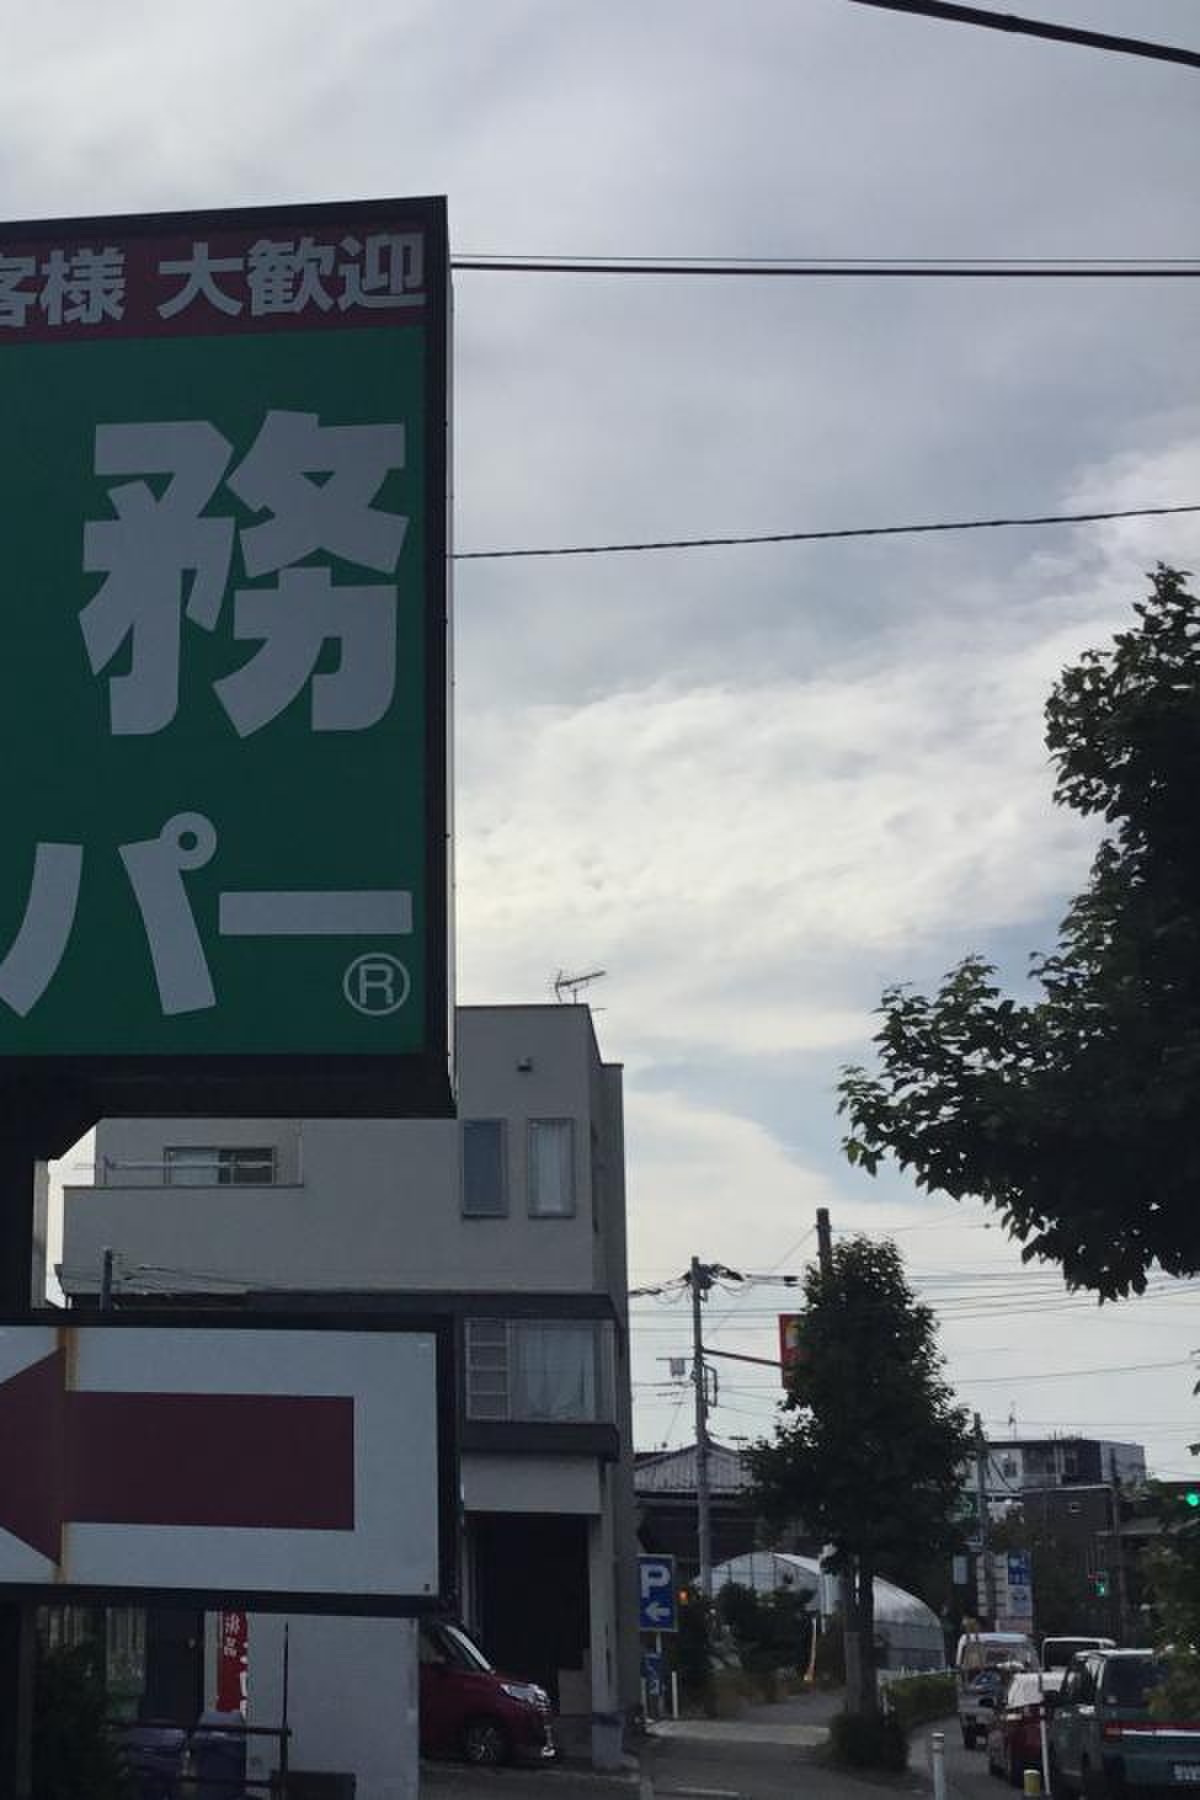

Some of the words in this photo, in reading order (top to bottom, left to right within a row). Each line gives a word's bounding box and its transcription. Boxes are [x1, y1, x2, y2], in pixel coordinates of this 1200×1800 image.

[157, 233, 424, 319] 大歓迎
[640, 1564, 671, 1600] P
